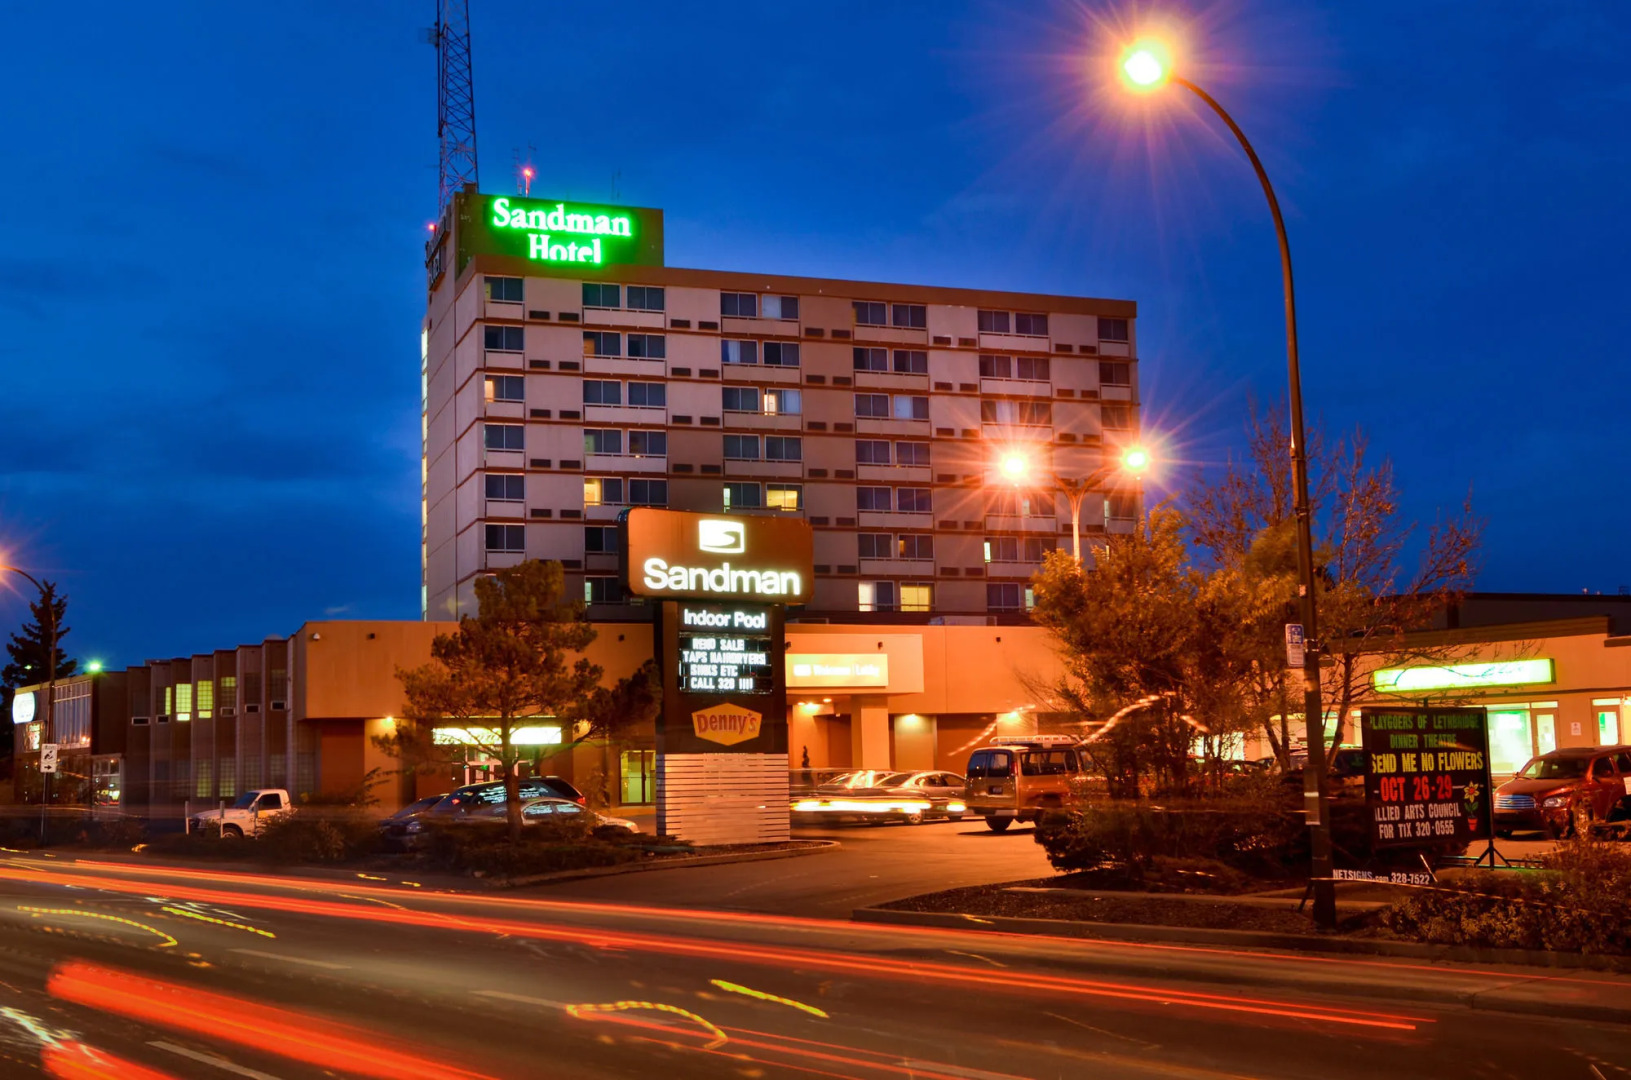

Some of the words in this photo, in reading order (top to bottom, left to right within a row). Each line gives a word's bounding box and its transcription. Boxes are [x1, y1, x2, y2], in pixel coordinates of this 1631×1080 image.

[492, 197, 632, 237] Sandman
[528, 233, 602, 264] Hotel
[643, 557, 801, 596] Sandman
[684, 609, 731, 626] Indoor
[734, 611, 766, 629] Pool
[720, 639, 745, 651] SALE
[683, 651, 708, 663] TAPS
[690, 664, 718, 677] SINKS
[720, 665, 738, 677] ETC
[690, 677, 715, 689] CALL
[696, 712, 757, 735] Denny's
[1417, 715, 1428, 730] OF
[1390, 734, 1418, 748] DINNER
[1424, 733, 1457, 748] THEATRE
[1401, 753, 1417, 773] ME
[1421, 753, 1434, 771] NO
[1438, 752, 1483, 771] FLOWERS
[1381, 777, 1405, 801] OCT
[1405, 803, 1424, 820] ARTS
[1428, 802, 1461, 818] COUNCIL
[1379, 824, 1394, 839] FOR
[1398, 822, 1412, 837] TIX
[1391, 872, 1430, 885] 328-7522
